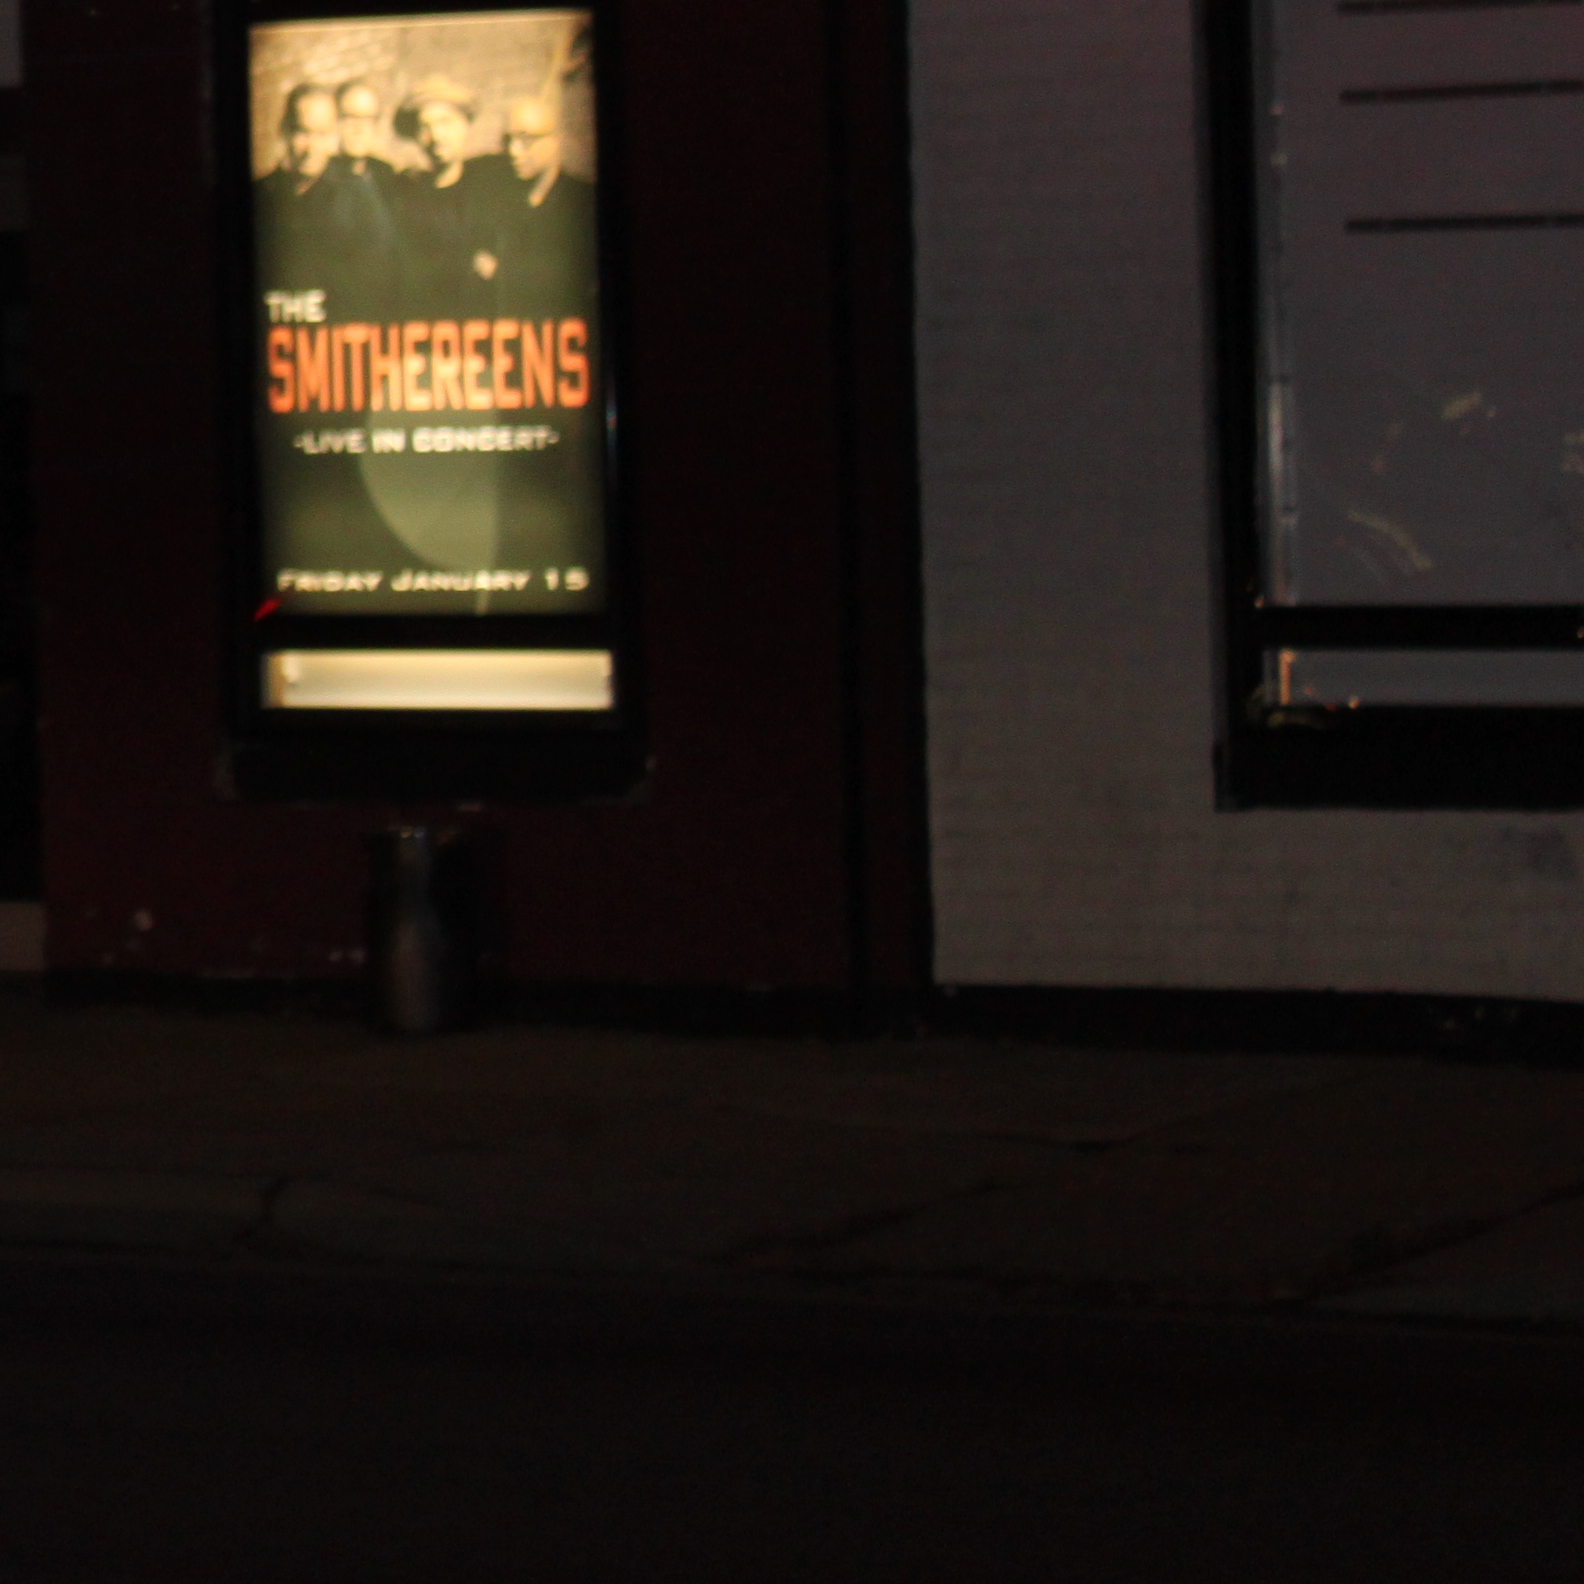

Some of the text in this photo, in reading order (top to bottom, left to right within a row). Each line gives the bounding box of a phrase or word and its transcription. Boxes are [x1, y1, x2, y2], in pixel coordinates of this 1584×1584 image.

[265, 289, 327, 323] THE
[267, 317, 590, 414] SMITHEREENS
[371, 428, 407, 454] IN
[277, 569, 382, 593] FRIDAY
[390, 568, 531, 592] JANUARY
